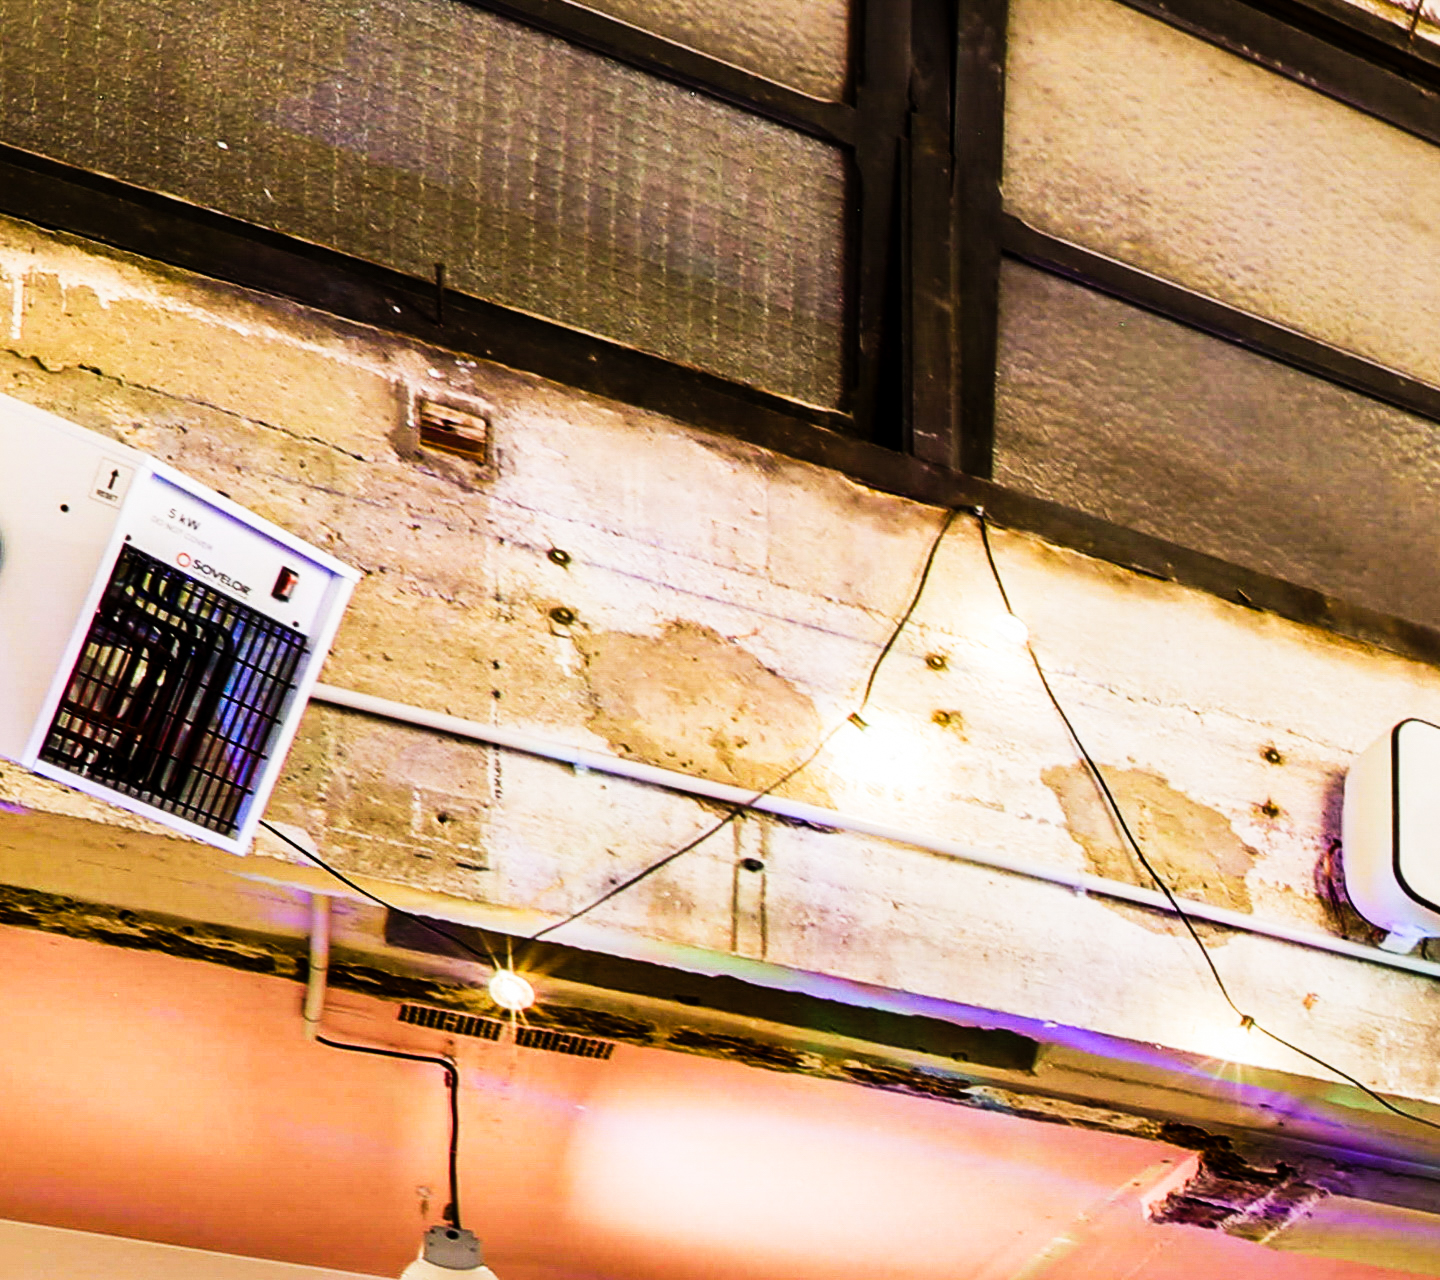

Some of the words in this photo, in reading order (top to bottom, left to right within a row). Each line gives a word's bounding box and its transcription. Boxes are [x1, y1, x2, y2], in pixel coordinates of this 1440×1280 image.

[168, 508, 177, 519] 5
[179, 515, 201, 531] kW
[191, 559, 252, 595] SOVELOR
